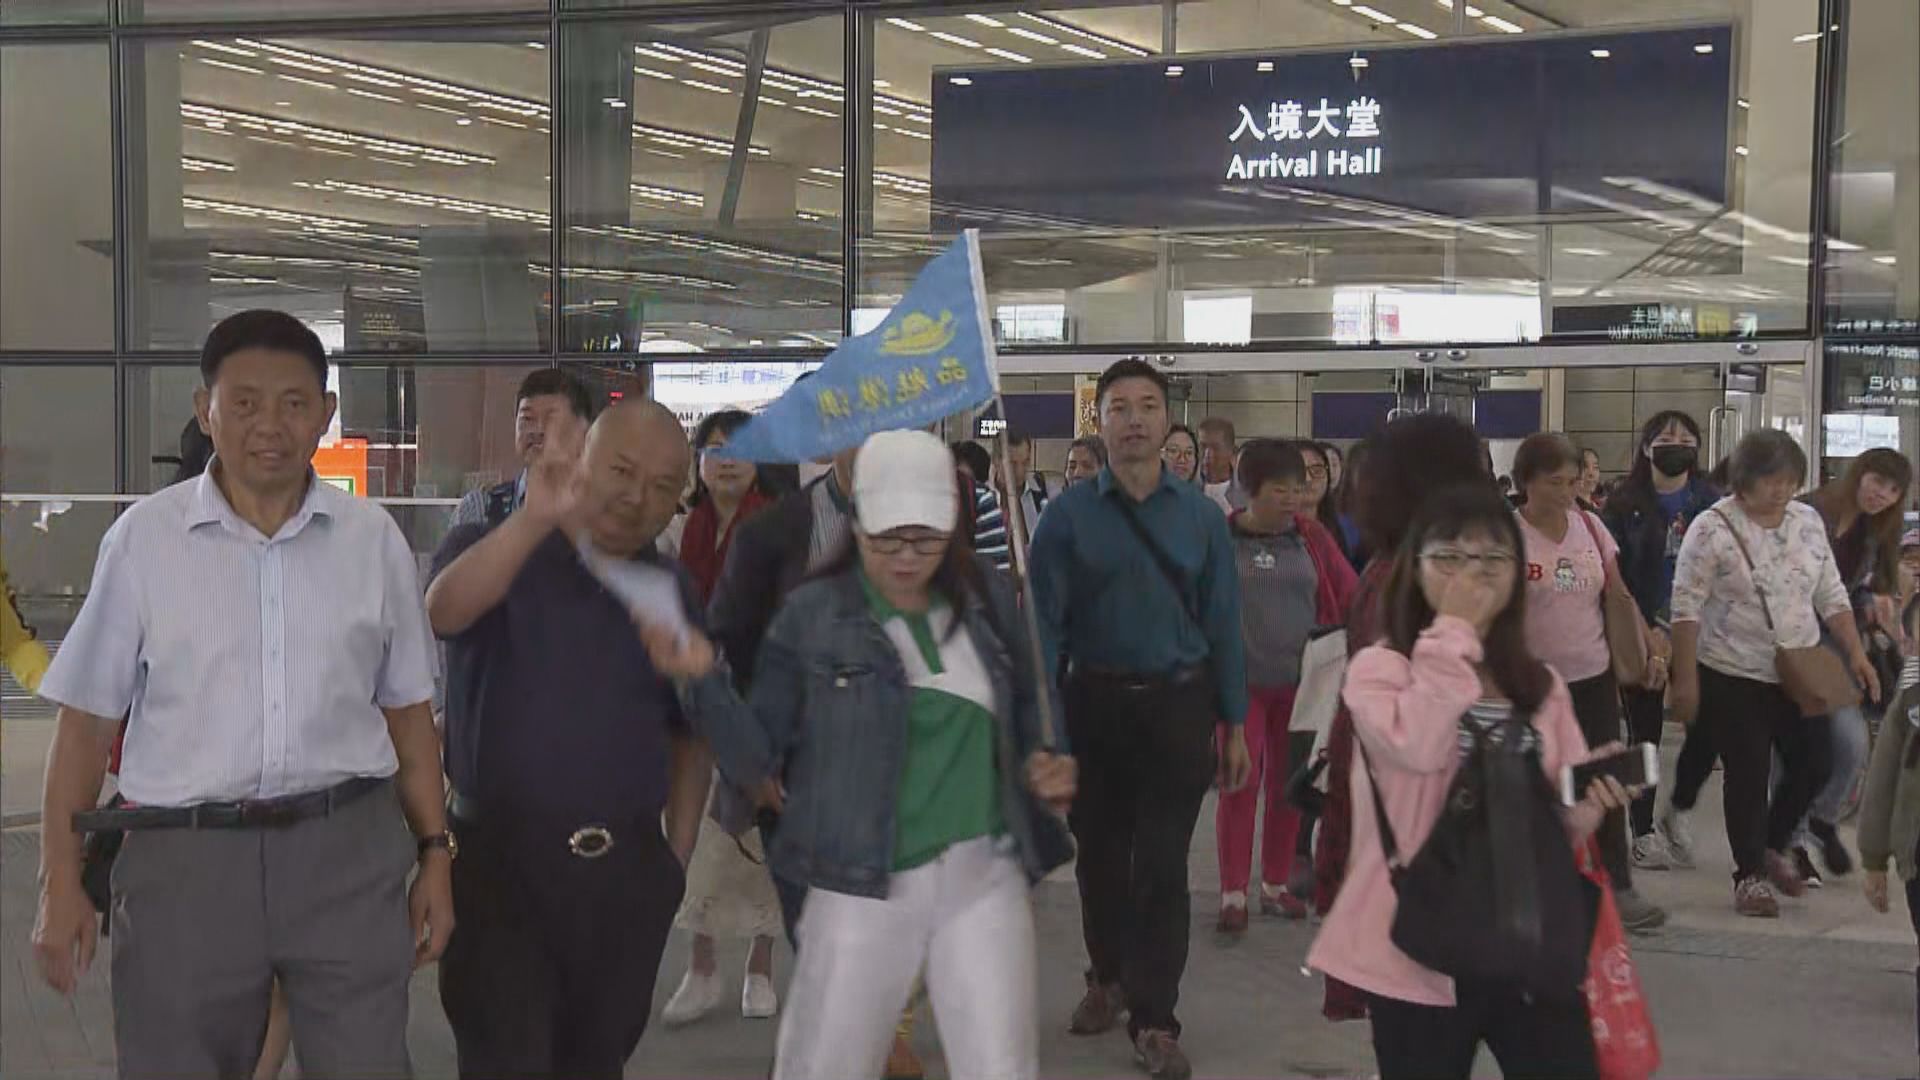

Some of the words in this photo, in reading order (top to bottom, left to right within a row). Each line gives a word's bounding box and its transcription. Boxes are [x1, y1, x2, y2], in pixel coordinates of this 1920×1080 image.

[1228, 96, 1381, 142] 入境大堂
[1226, 150, 1317, 180] Arrival
[1327, 147, 1381, 176] Hall
